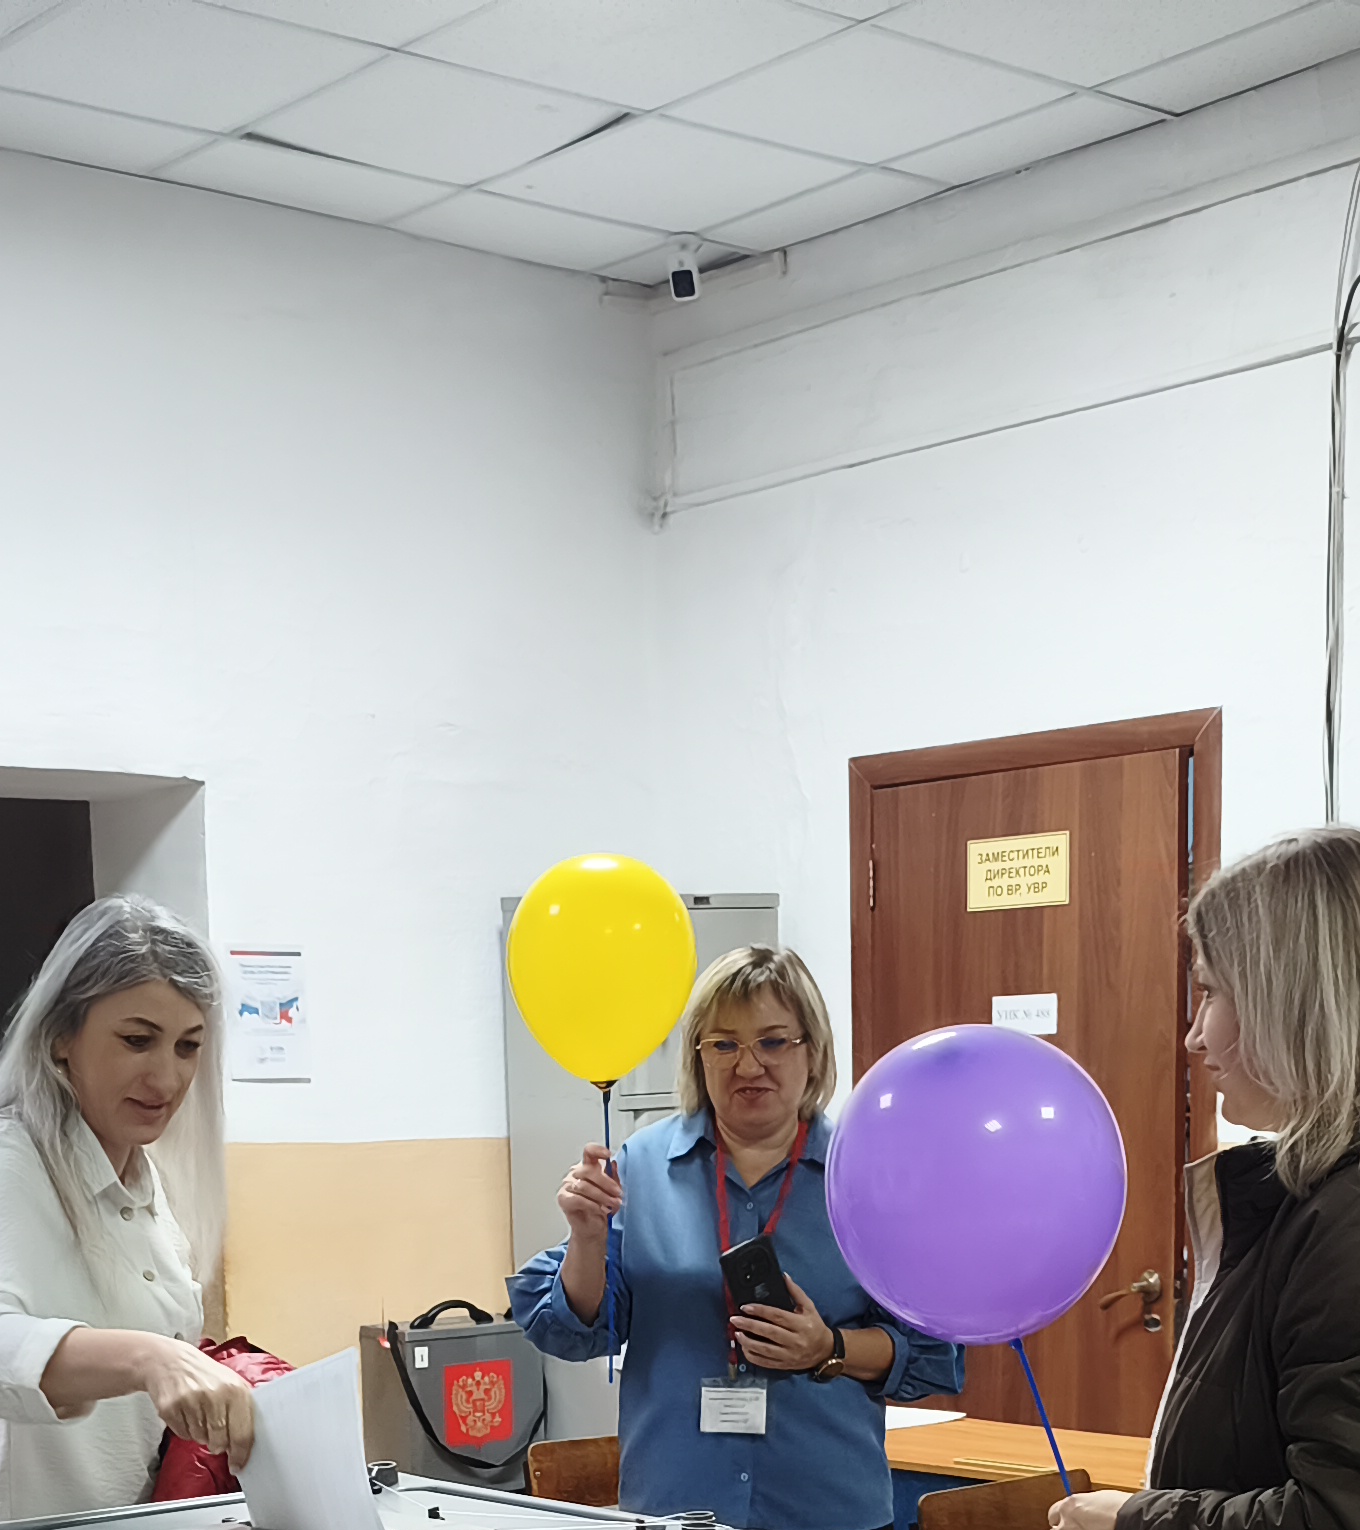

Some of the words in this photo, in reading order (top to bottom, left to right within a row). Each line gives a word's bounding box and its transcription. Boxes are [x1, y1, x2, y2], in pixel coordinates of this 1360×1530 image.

[977, 845, 1060, 866] ЗАМЕСТИТЕЛИ
[984, 864, 1051, 883] ДИРЕКТОРА
[987, 884, 1004, 898] ПО
[1026, 881, 1048, 895] УВР
